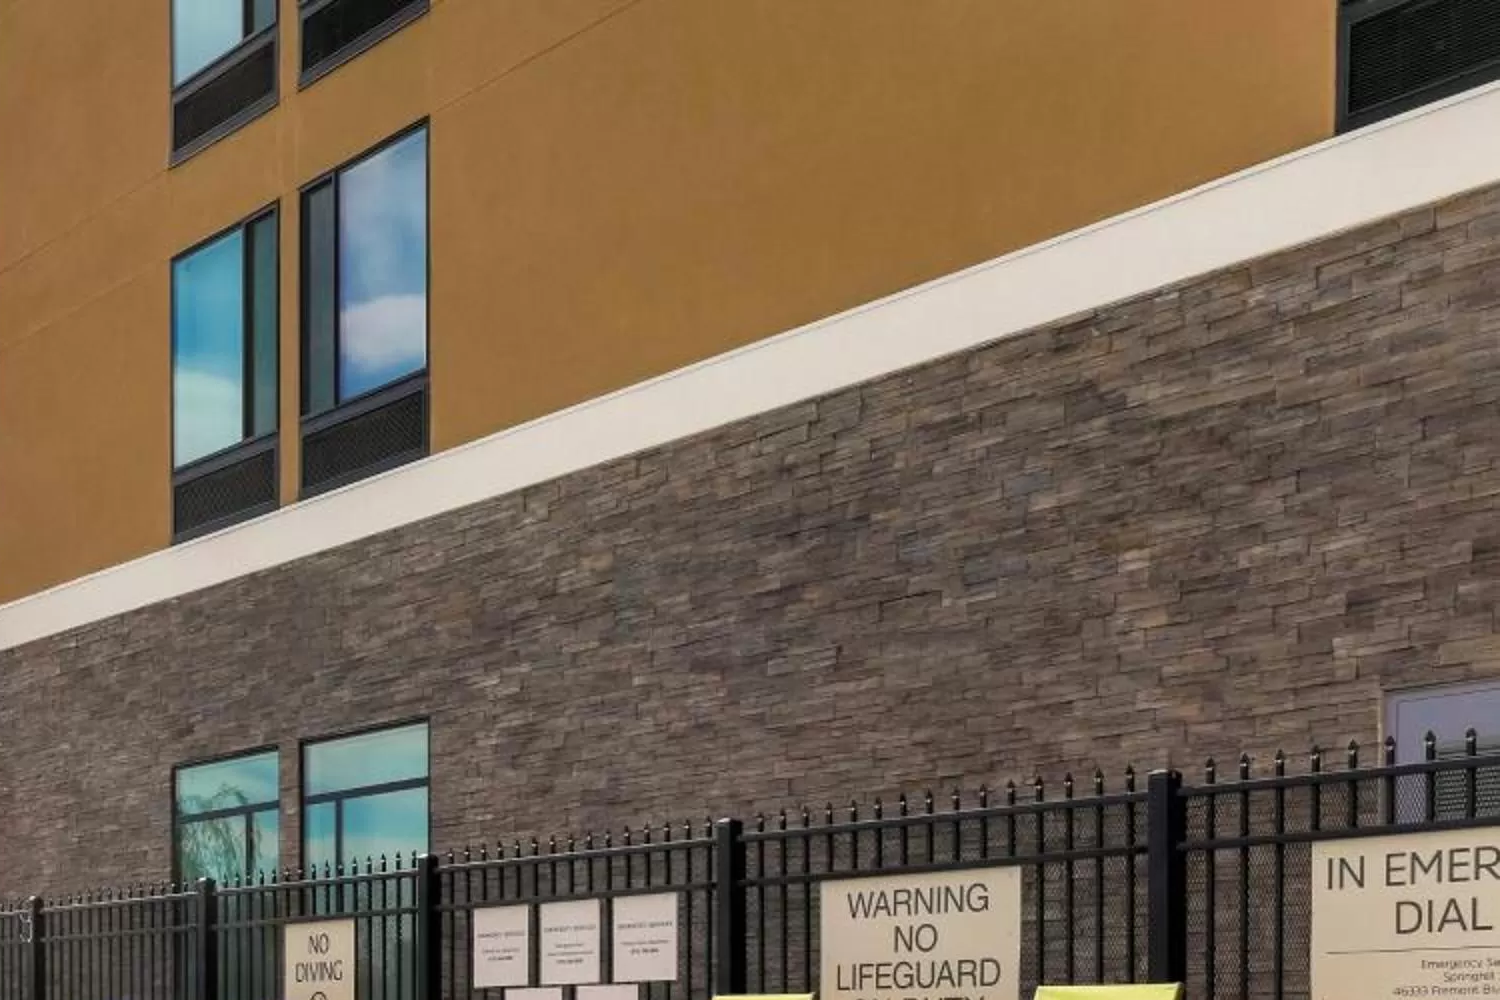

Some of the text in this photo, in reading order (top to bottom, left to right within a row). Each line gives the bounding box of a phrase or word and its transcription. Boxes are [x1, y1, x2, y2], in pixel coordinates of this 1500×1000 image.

[1326, 846, 1500, 890] IN EMER
[847, 883, 989, 919] WARNING
[1395, 897, 1493, 935] DIAL
[308, 932, 330, 955] NO
[893, 923, 939, 953] NO
[295, 960, 343, 983] DIVING
[836, 958, 1001, 991] LIFEGUARD
